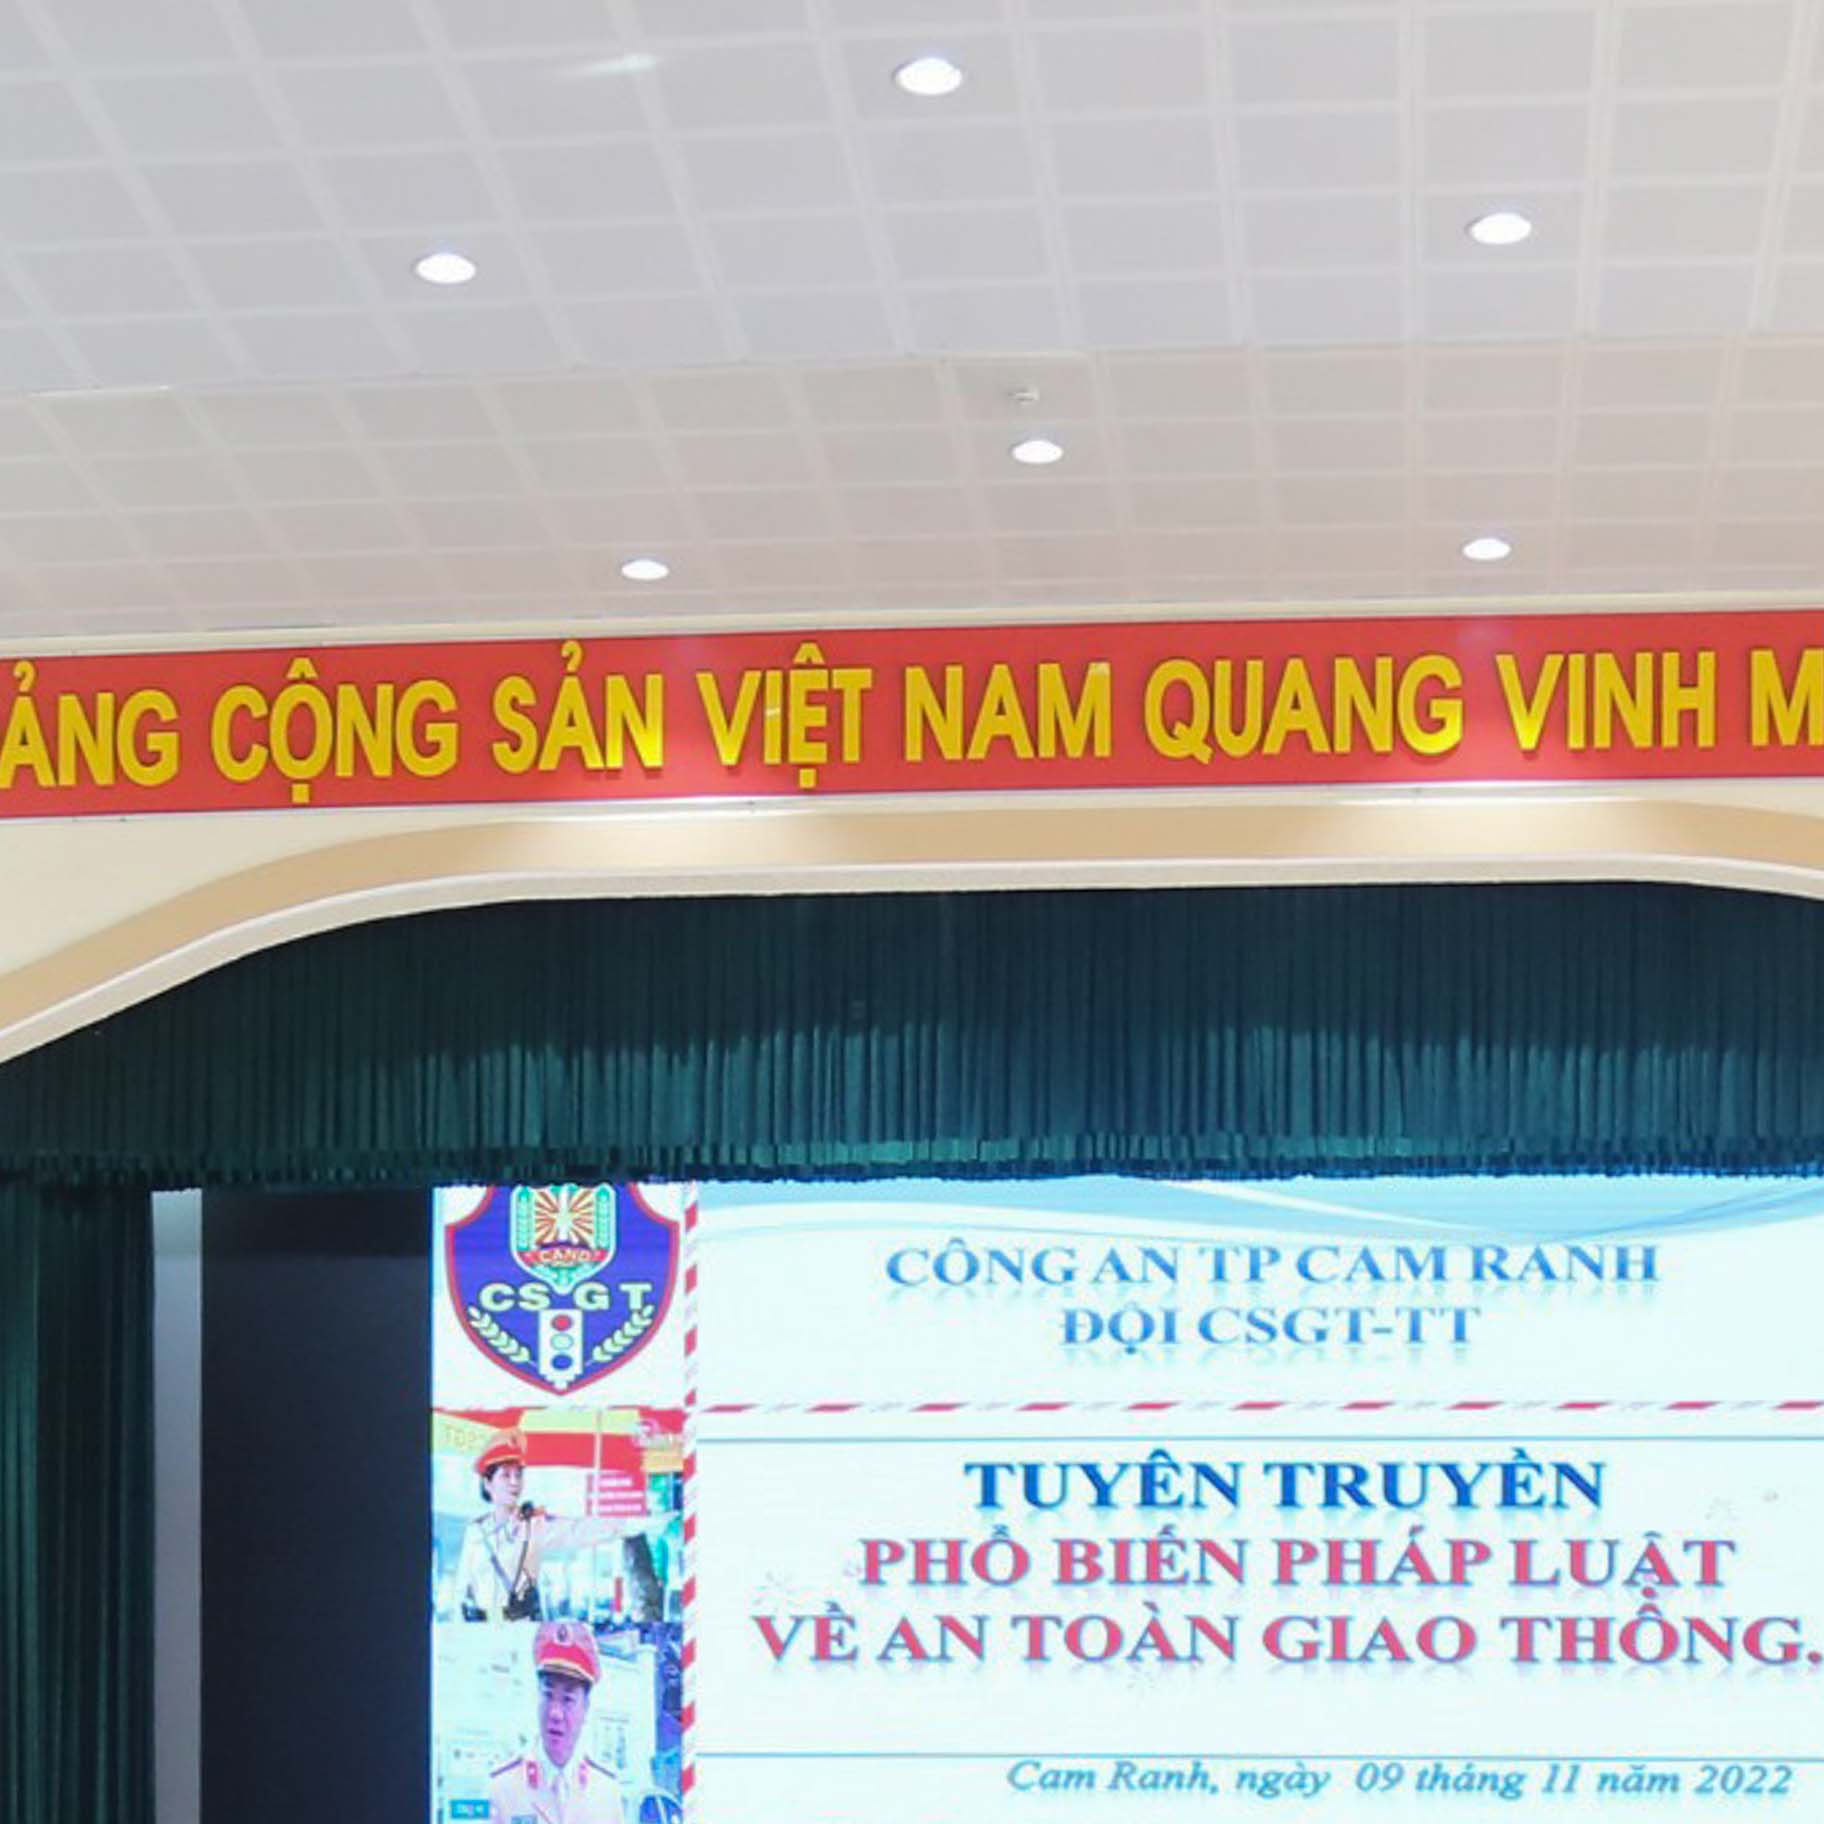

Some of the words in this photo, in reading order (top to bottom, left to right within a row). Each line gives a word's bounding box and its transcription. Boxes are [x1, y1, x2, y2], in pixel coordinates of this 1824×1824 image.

[212, 657, 458, 803] CỘNG
[493, 641, 664, 773] SẢN
[697, 644, 871, 788] VIỆT
[905, 663, 1111, 763] NAM
[1144, 655, 1464, 766] QUANG
[1496, 651, 1716, 756] VINH
[886, 1237, 1077, 1287] CÔNG
[1093, 1246, 1178, 1284] AN
[1199, 1246, 1282, 1284] TP
[1296, 1244, 1448, 1284] CAM
[1471, 1244, 1660, 1283] RANH
[1060, 1302, 1179, 1354] ĐỘI
[1197, 1304, 1482, 1346] CSGT-TT
[963, 1448, 1245, 1510] TUYÊN
[1263, 1447, 1606, 1509] TRUYỀN
[860, 1524, 1030, 1587] PHỔ
[1053, 1523, 1249, 1587] BIẾN
[1272, 1525, 1493, 1587] PHÁP
[1509, 1530, 1736, 1599] LUẬT
[751, 1602, 860, 1663] VỀ
[877, 1615, 991, 1663] AN
[1011, 1602, 1240, 1663] TOÀN
[1263, 1615, 1477, 1664] GIAO
[1500, 1602, 1824, 1666] THÔNG.
[1006, 1759, 1095, 1792] Cam
[1108, 1760, 1219, 1796] Ranh,
[1235, 1762, 1331, 1799] ngày
[1355, 1761, 1405, 1793] 09
[1415, 1762, 1527, 1800] tháng
[1541, 1763, 1581, 1794] 11
[1596, 1764, 1681, 1795] năm
[1694, 1764, 1795, 1796] 2022
